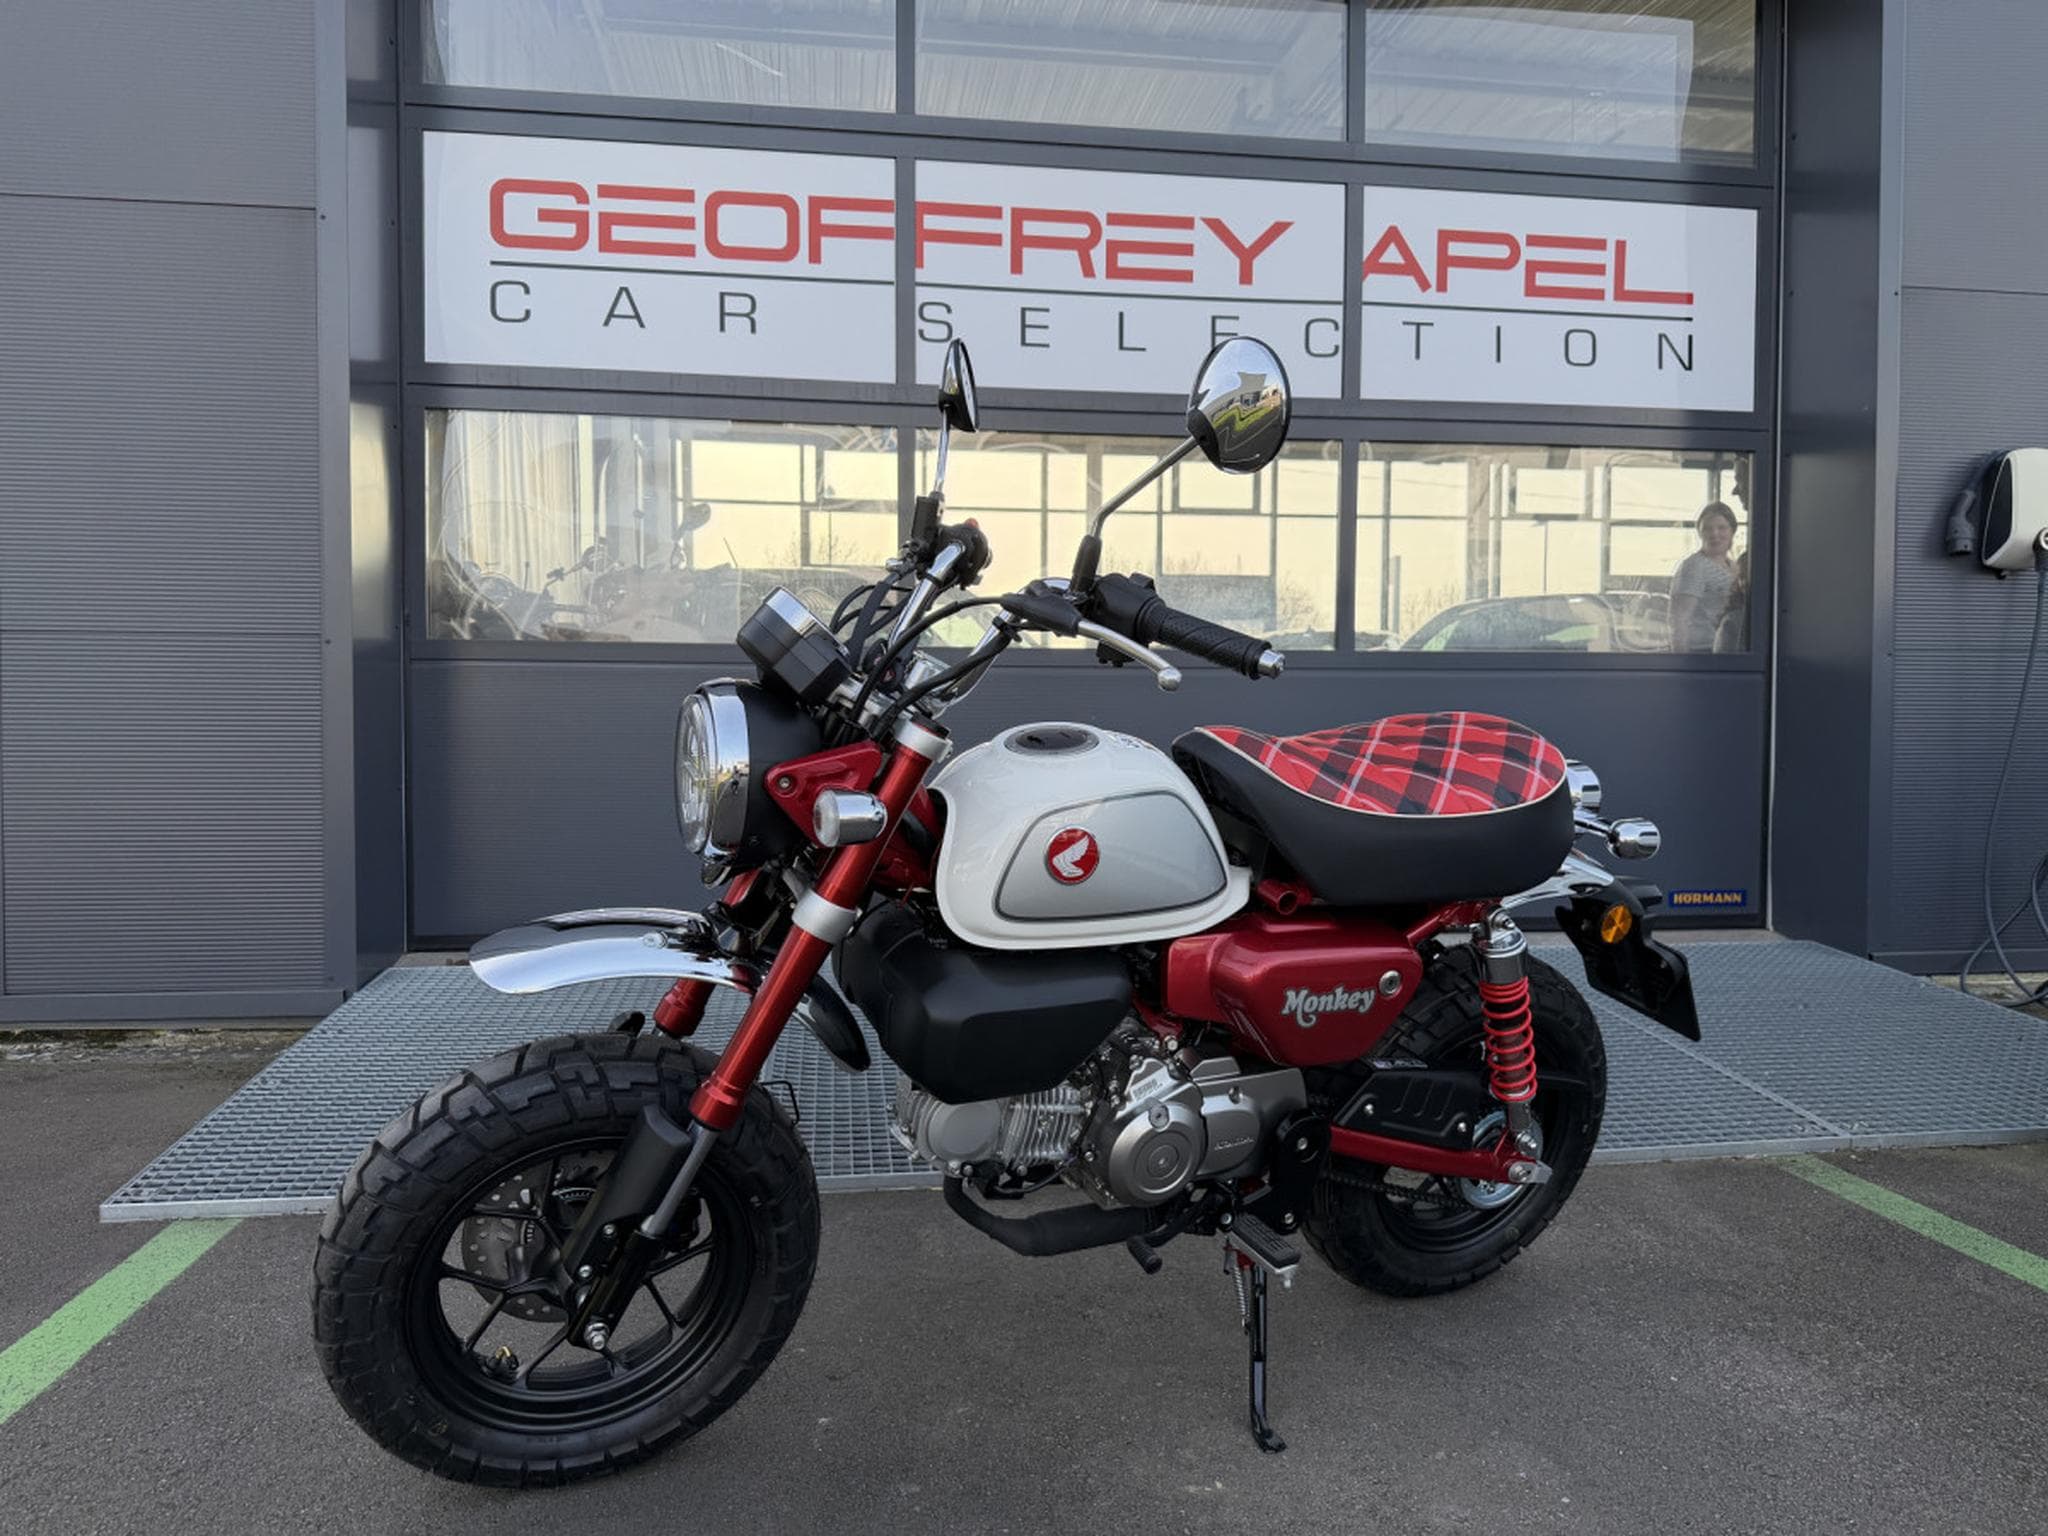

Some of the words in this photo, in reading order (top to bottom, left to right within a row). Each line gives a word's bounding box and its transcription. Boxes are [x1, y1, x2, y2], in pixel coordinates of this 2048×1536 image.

[489, 178, 1293, 285] GEOFFREY
[1362, 225, 1693, 304] APEL
[490, 281, 757, 334] CAR
[917, 300, 1694, 371] SELECTION
[1281, 985, 1375, 1027] Monkey
